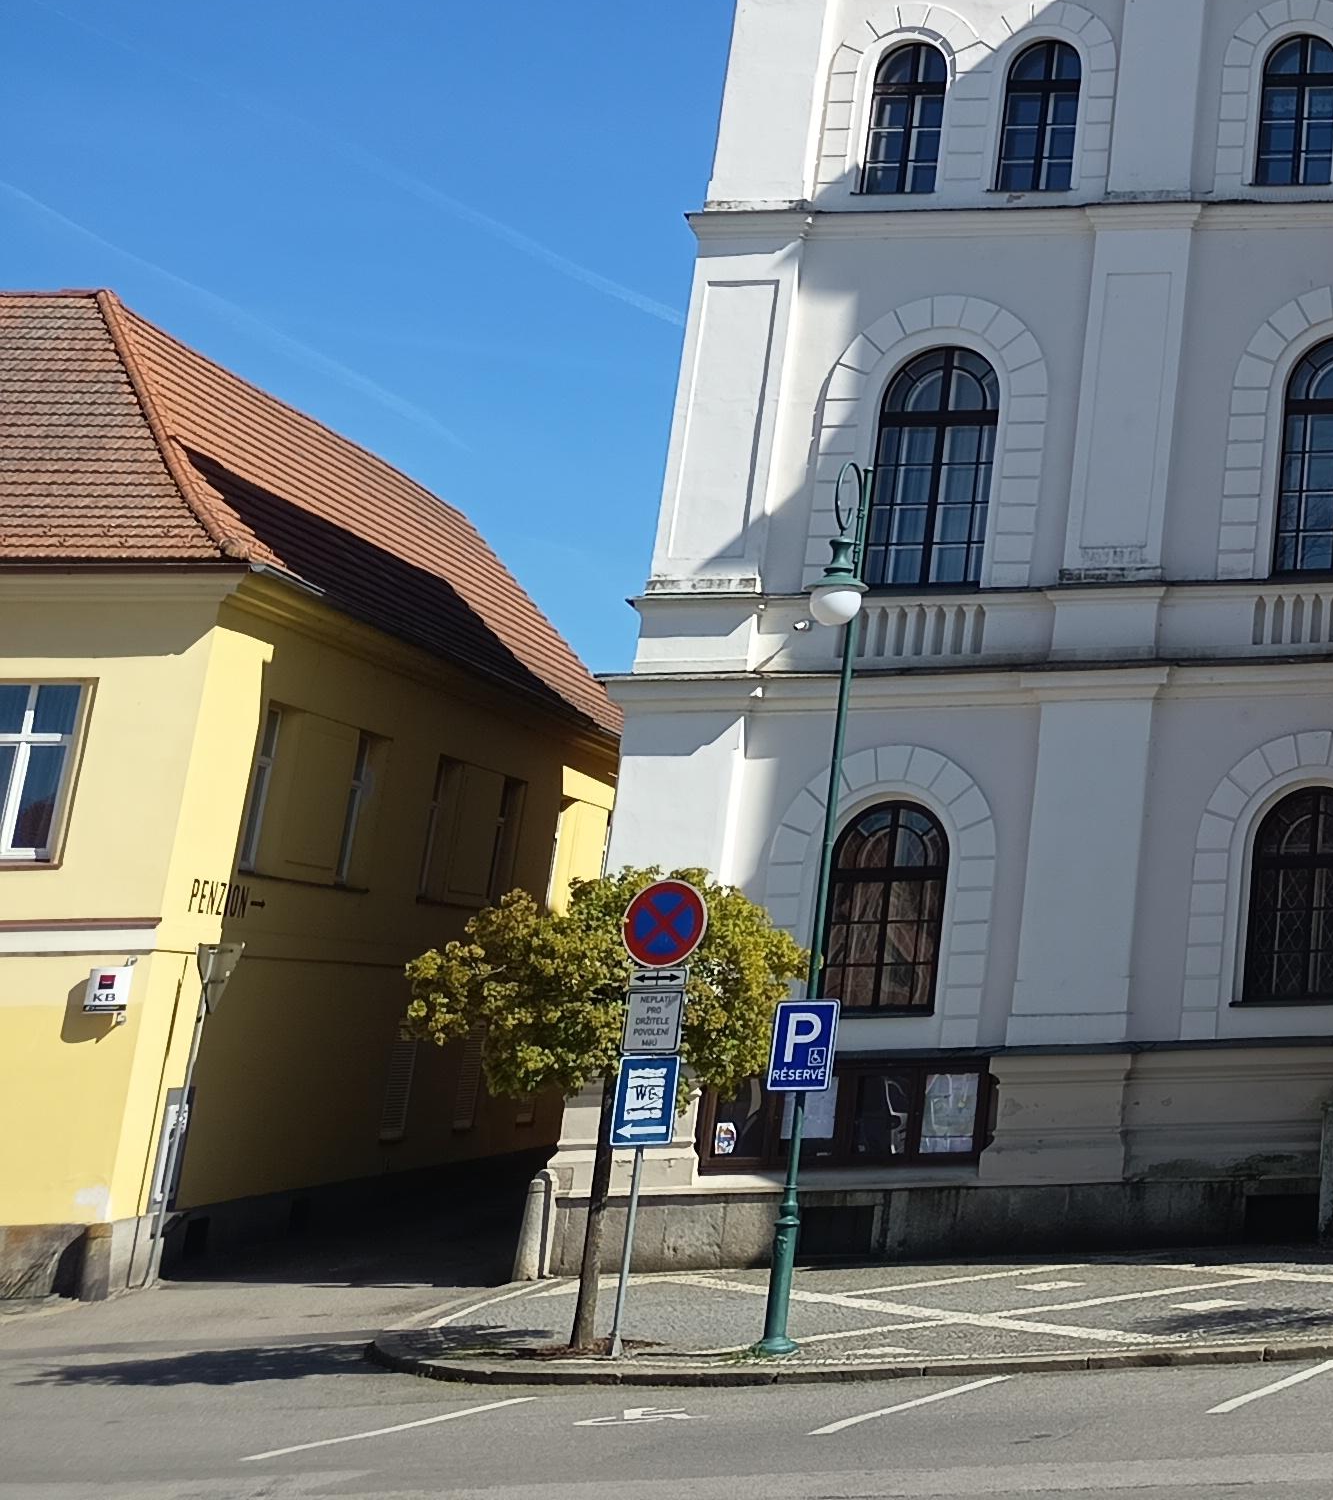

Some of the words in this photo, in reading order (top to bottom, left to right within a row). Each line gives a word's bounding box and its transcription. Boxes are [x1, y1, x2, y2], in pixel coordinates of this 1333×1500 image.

[188, 878, 250, 919] PENZION
[92, 993, 116, 1002] KB
[783, 1012, 823, 1063] P
